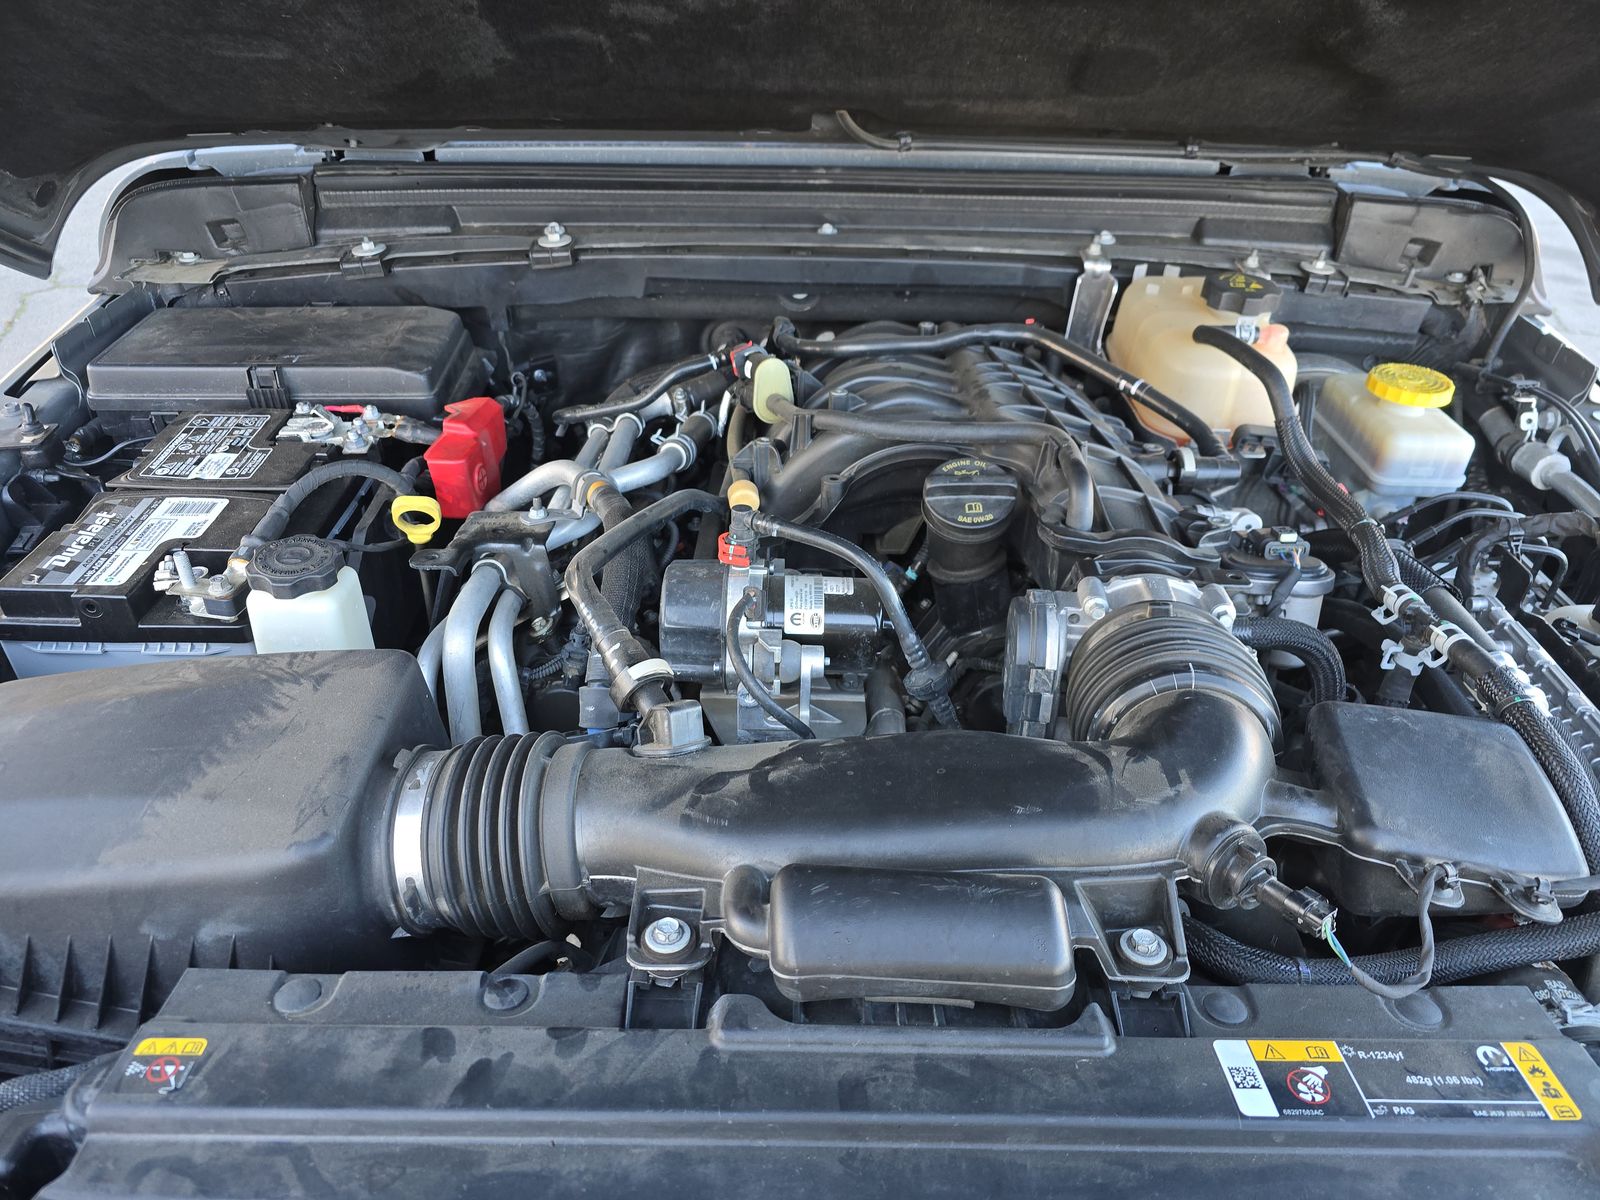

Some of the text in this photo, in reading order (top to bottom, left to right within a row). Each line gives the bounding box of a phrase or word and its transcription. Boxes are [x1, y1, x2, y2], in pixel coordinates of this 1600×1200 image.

[942, 459, 971, 472] ENGINE
[957, 515, 973, 523] SAE
[43, 511, 117, 569] Duralast
[82, 553, 99, 568] AGM
[97, 515, 135, 553] TECHNOLOGY
[1544, 979, 1567, 990] RAD
[1357, 1050, 1405, 1061] R-1234yf
[1433, 1075, 1460, 1087] (1.06
[1461, 1076, 1484, 1087] lbs)
[1393, 1106, 1416, 1116] PAG
